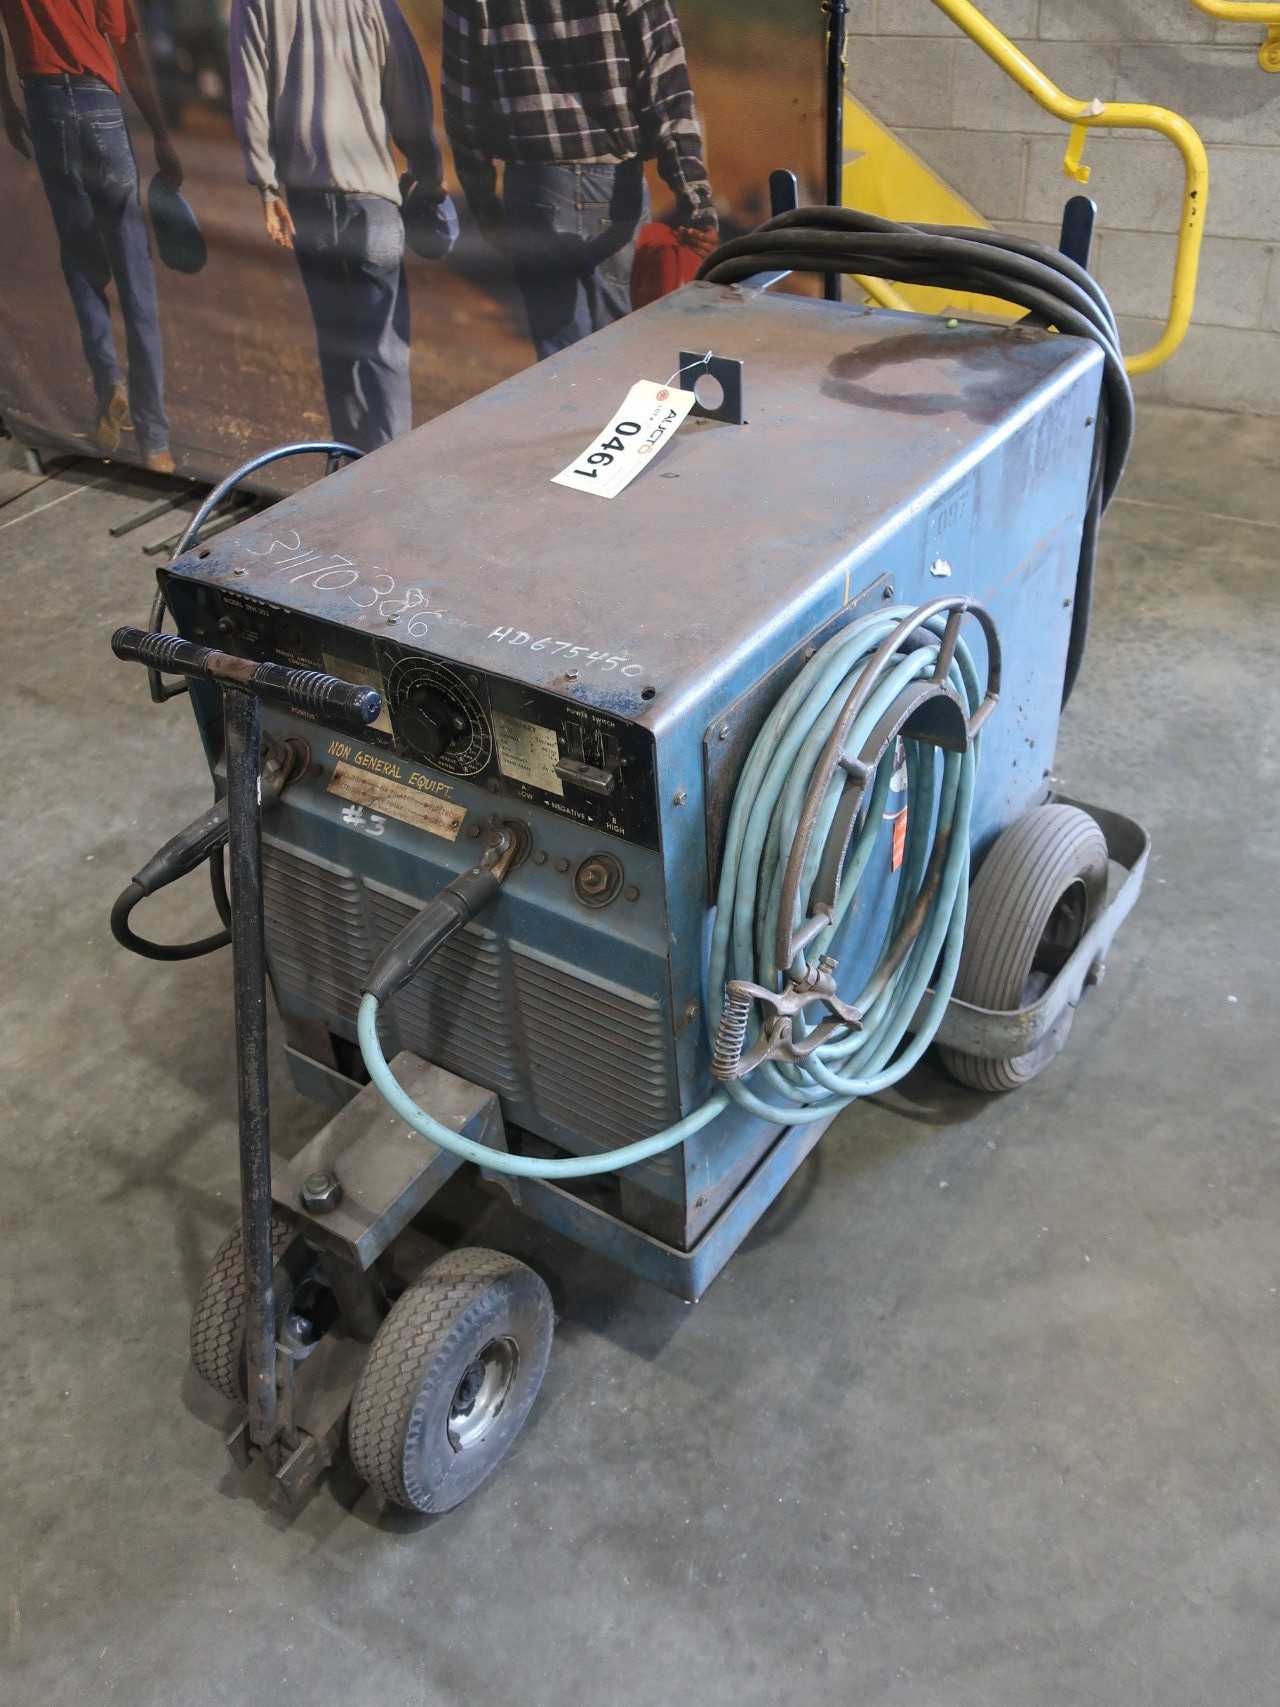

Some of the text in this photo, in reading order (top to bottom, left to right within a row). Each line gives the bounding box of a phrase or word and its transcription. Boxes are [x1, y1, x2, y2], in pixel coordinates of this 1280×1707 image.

[573, 421, 641, 478] 0461
[487, 626, 643, 677] HD675450
[328, 740, 352, 760] NON
[354, 751, 402, 778] GENERAL
[342, 804, 387, 836] #3
[551, 802, 585, 820] NEGATIVE
[606, 822, 625, 835] HIGH
